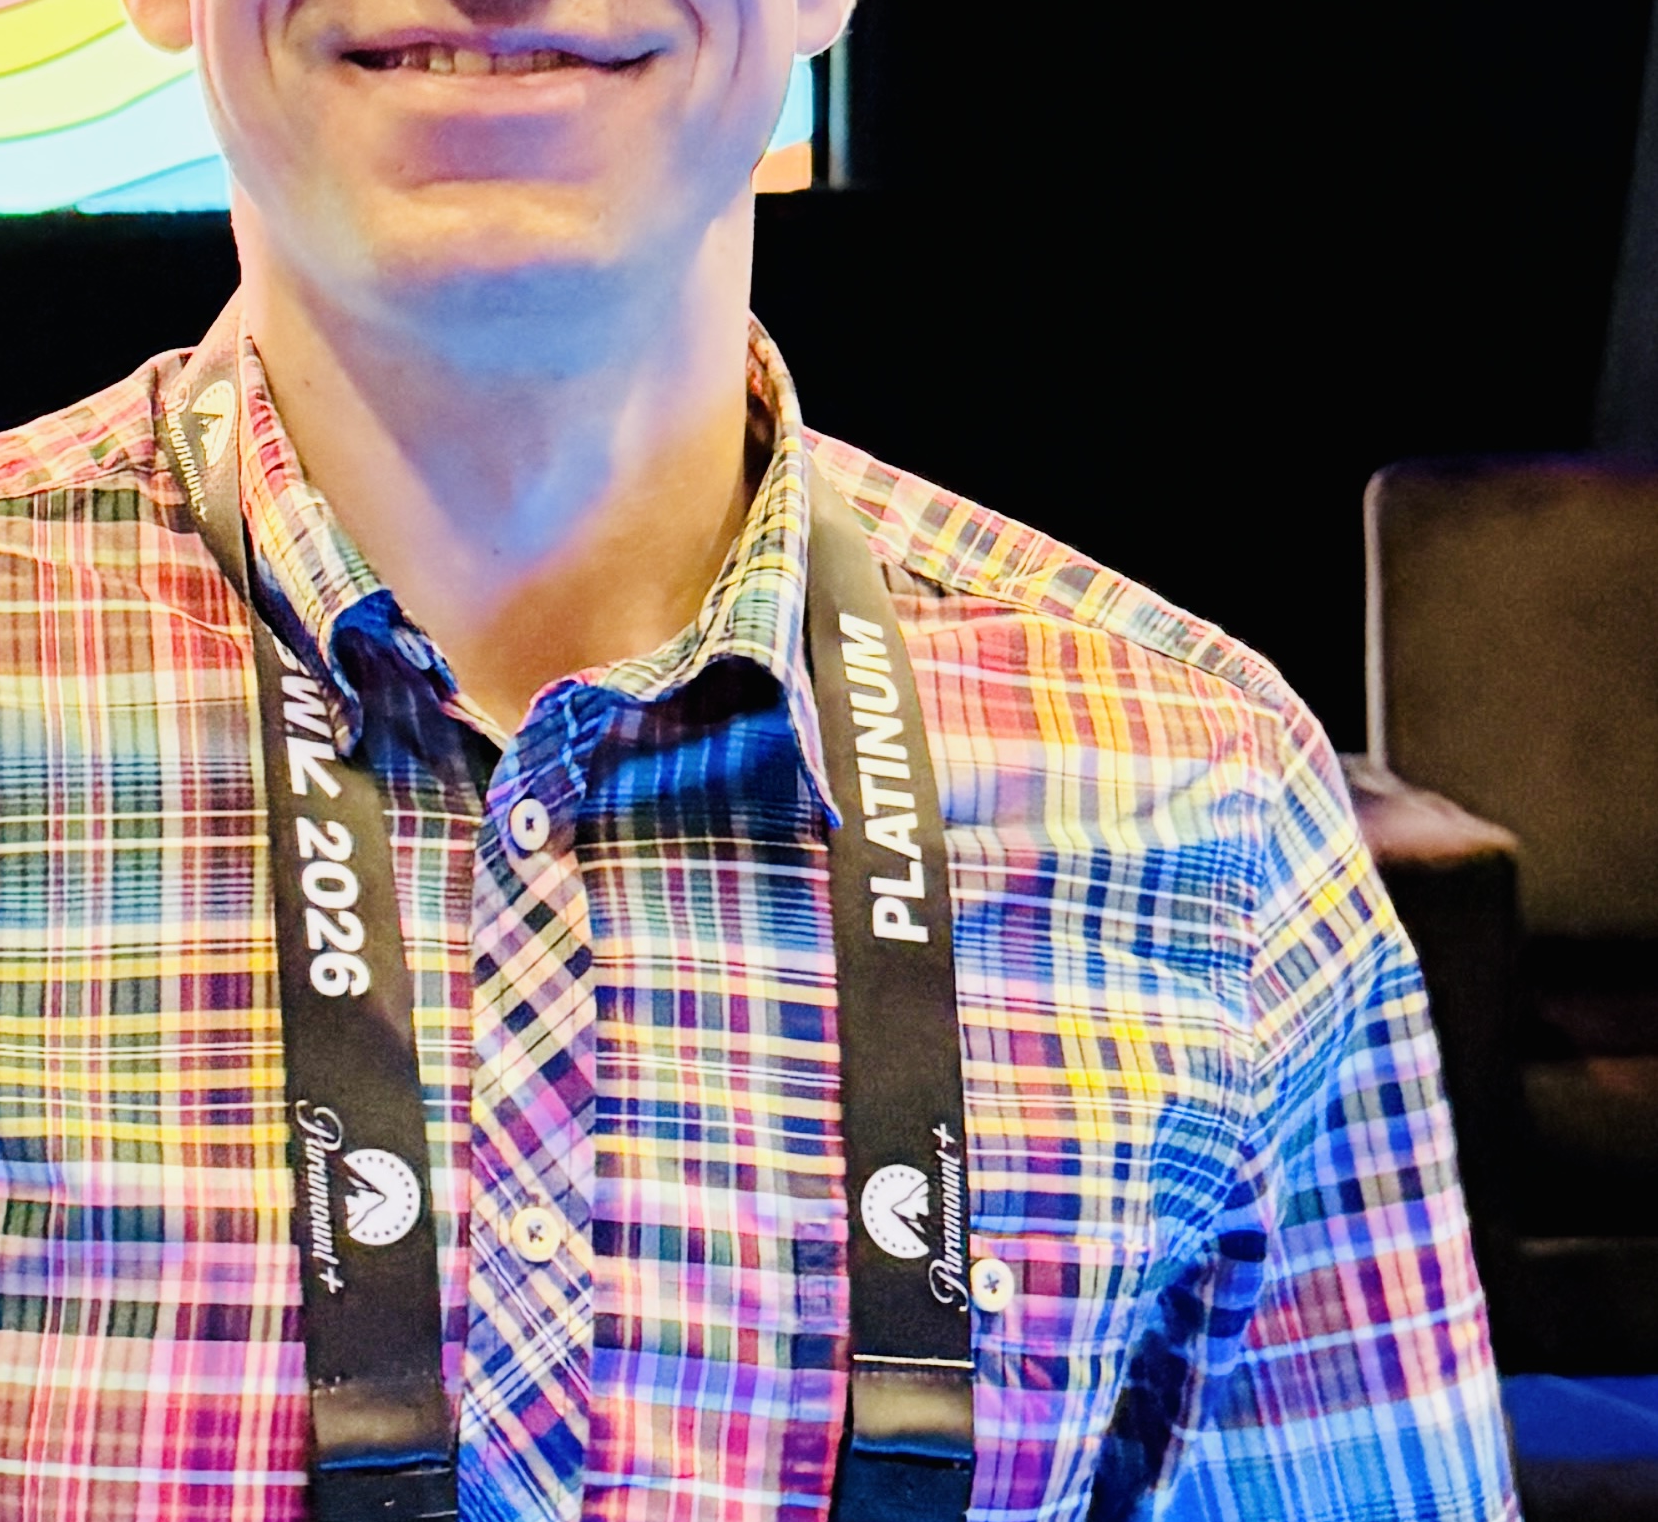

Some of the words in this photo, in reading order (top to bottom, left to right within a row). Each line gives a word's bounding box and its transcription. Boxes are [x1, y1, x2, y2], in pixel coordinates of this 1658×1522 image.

[838, 613, 931, 944] PLATINUM
[295, 816, 371, 997] 2026
[296, 1105, 346, 1293] Paramount+
[929, 1123, 970, 1312] Paramount+
